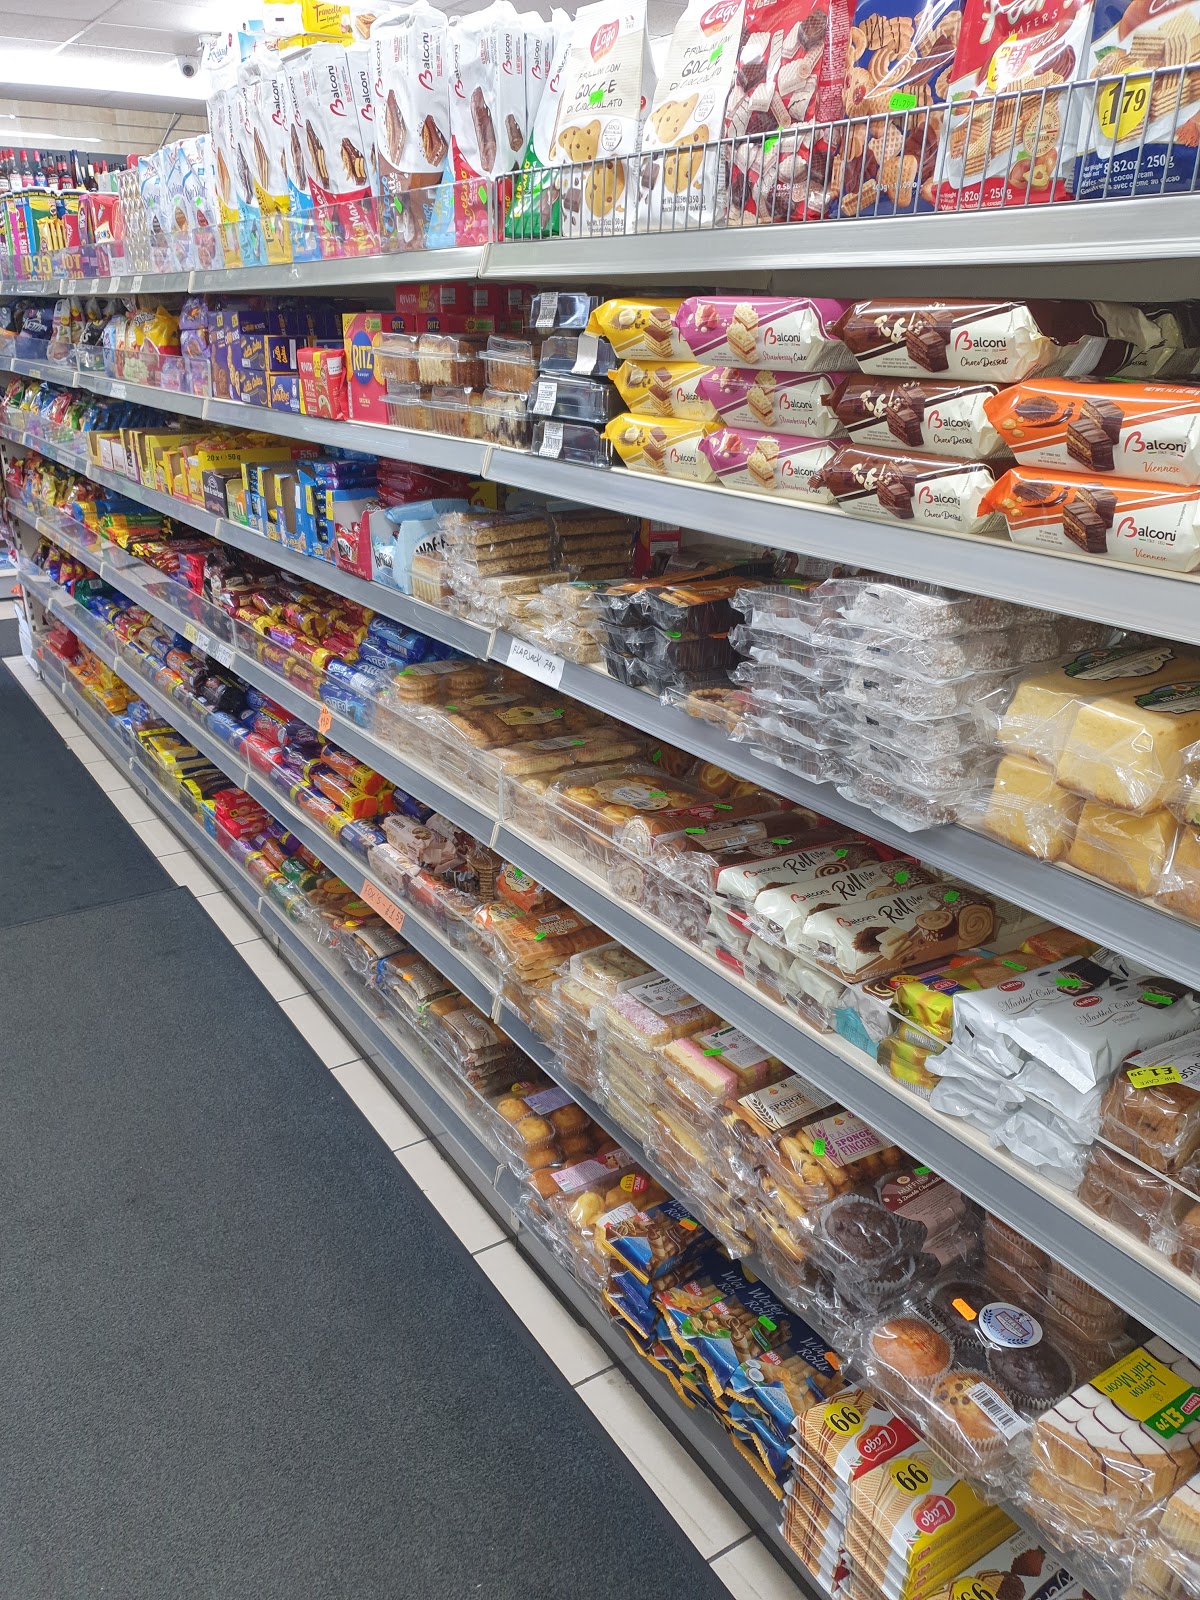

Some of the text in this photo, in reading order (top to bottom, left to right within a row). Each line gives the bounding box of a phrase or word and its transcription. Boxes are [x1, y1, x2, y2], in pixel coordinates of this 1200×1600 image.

[704, 4, 739, 25] Lago
[593, 28, 616, 50] Lago
[418, 32, 434, 91] Balconi
[502, 34, 514, 75] Balconi
[531, 39, 542, 79] Balconi
[455, 44, 466, 98] Balconi
[330, 66, 347, 117] Balconi
[361, 71, 375, 121] Balconi
[272, 80, 283, 126] Balconi
[391, 320, 405, 330] RITZ
[427, 320, 440, 330] RITZ
[764, 326, 801, 347] Balconi
[955, 331, 1008, 353] Balconi
[352, 345, 374, 371] RITZ
[762, 351, 808, 365] Strawberry Cake
[304, 379, 315, 391] THE
[779, 392, 813, 411] Balconi
[778, 414, 808, 427] Strawberry
[928, 410, 971, 431] Balconi
[1123, 431, 1187, 454] Balconi
[781, 460, 818, 479] Balconi
[1143, 461, 1181, 474] Viennese
[780, 480, 808, 495] Strawberry
[918, 486, 960, 507] Balconi
[1117, 517, 1177, 540] Balconi
[1133, 547, 1168, 562] Viennese
[323, 696, 347, 712] OREO
[783, 851, 816, 875] Roll
[364, 884, 382, 906] FOX'S
[790, 889, 830, 905] Balconi
[832, 872, 864, 900] Roll
[836, 913, 876, 928] Balconi
[879, 896, 912, 924] Roll
[411, 963, 440, 990] ORIGINAL
[1000, 986, 1057, 1014] Marbled Cake
[1075, 1008, 1113, 1026] Marbled
[1112, 1000, 1136, 1011] Cake
[1113, 1013, 1137, 1024] Premium
[1130, 1066, 1174, 1078] £1.39
[769, 1093, 804, 1112] SPONGE
[829, 1123, 866, 1140] RAISIN
[835, 1128, 872, 1147] SPONGE
[840, 1135, 880, 1156] FINGERS
[897, 1176, 929, 1195] MUFFINS
[902, 1188, 919, 1202] Double
[745, 1300, 776, 1321] Rolls
[748, 1287, 789, 1316] Wafer
[797, 1347, 831, 1373] Rolls
[1104, 1358, 1157, 1393] Half Moon
[1129, 1374, 1167, 1398] Lemon
[863, 1429, 893, 1453] Lago
[920, 1500, 952, 1526] Lago
